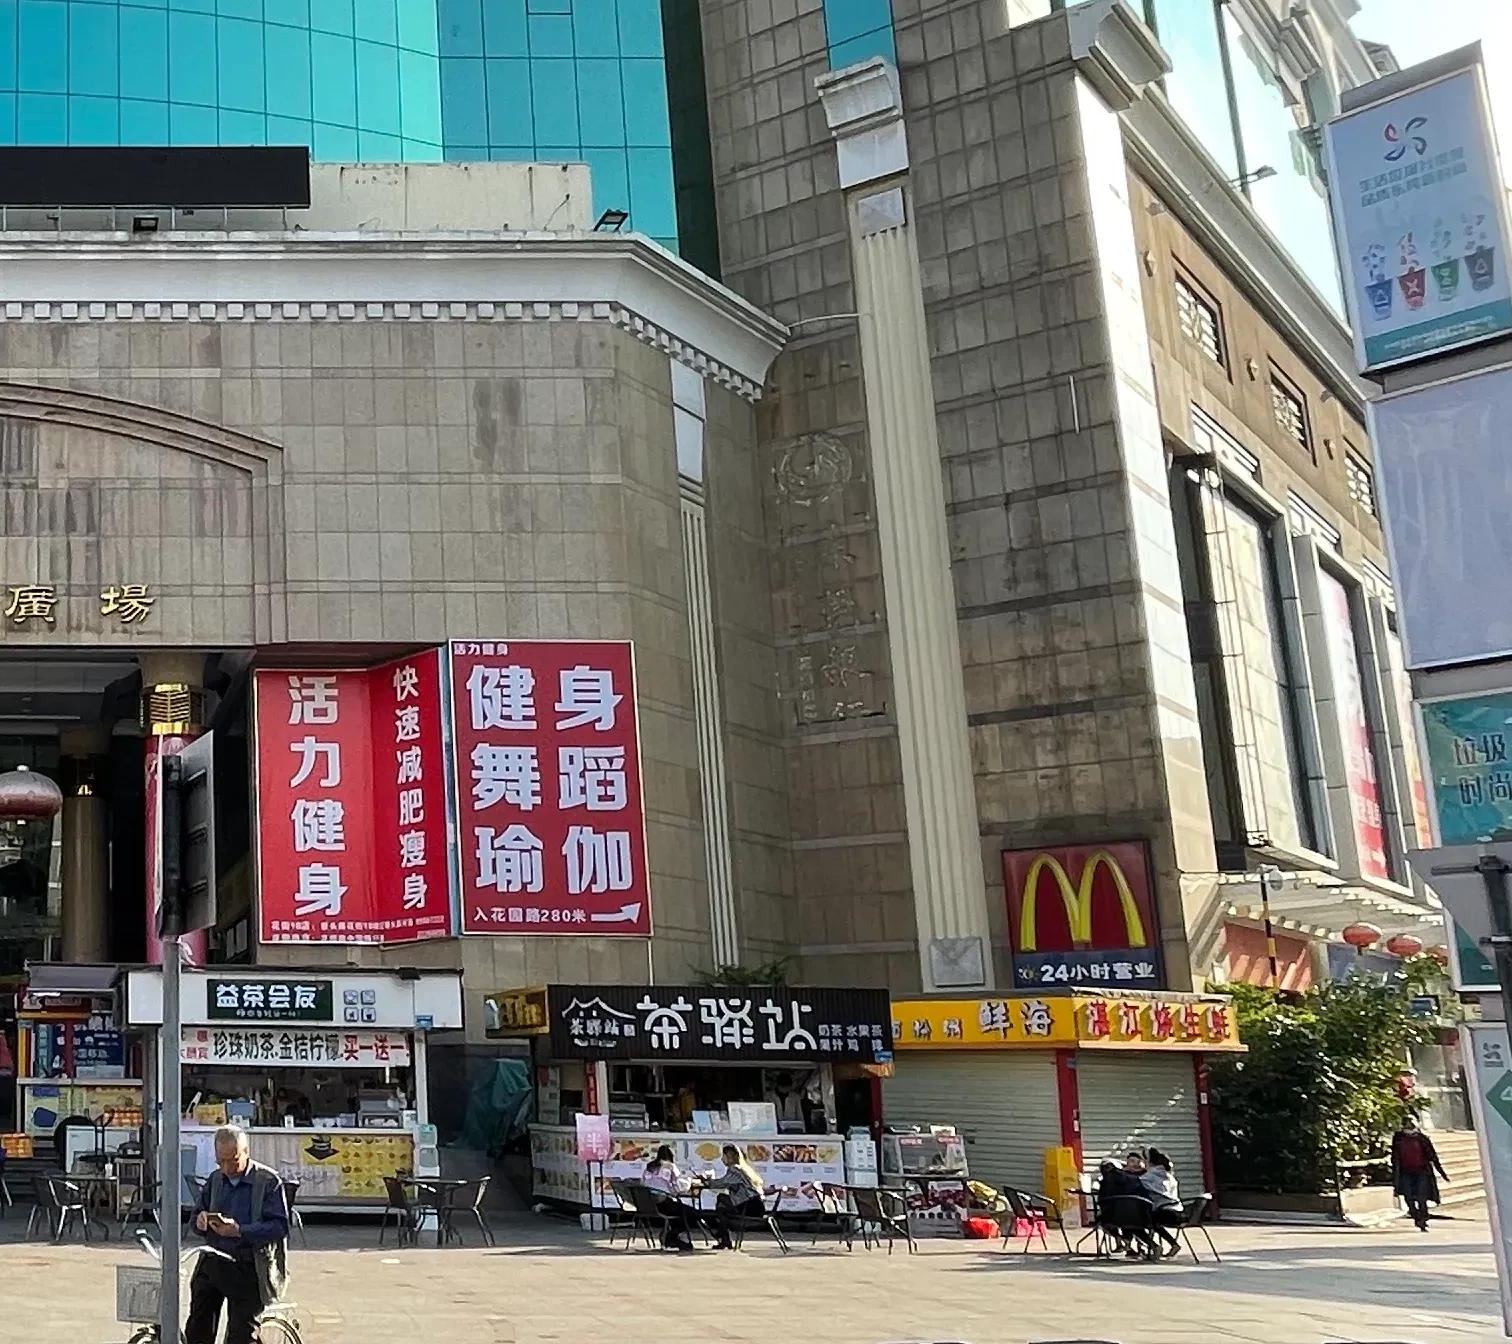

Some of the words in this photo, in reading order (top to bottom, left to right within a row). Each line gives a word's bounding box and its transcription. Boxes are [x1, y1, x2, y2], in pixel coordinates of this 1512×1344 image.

[466, 664, 625, 731] 健身
[288, 675, 348, 918] 活力健身
[393, 664, 429, 912] 快速减肥瘦身
[472, 745, 629, 812] 舞蹈
[475, 824, 633, 895] 瑜伽
[216, 984, 317, 1010] 益茶会友
[1040, 962, 1156, 983] 24小时营业
[636, 994, 818, 1050] 茶驿站
